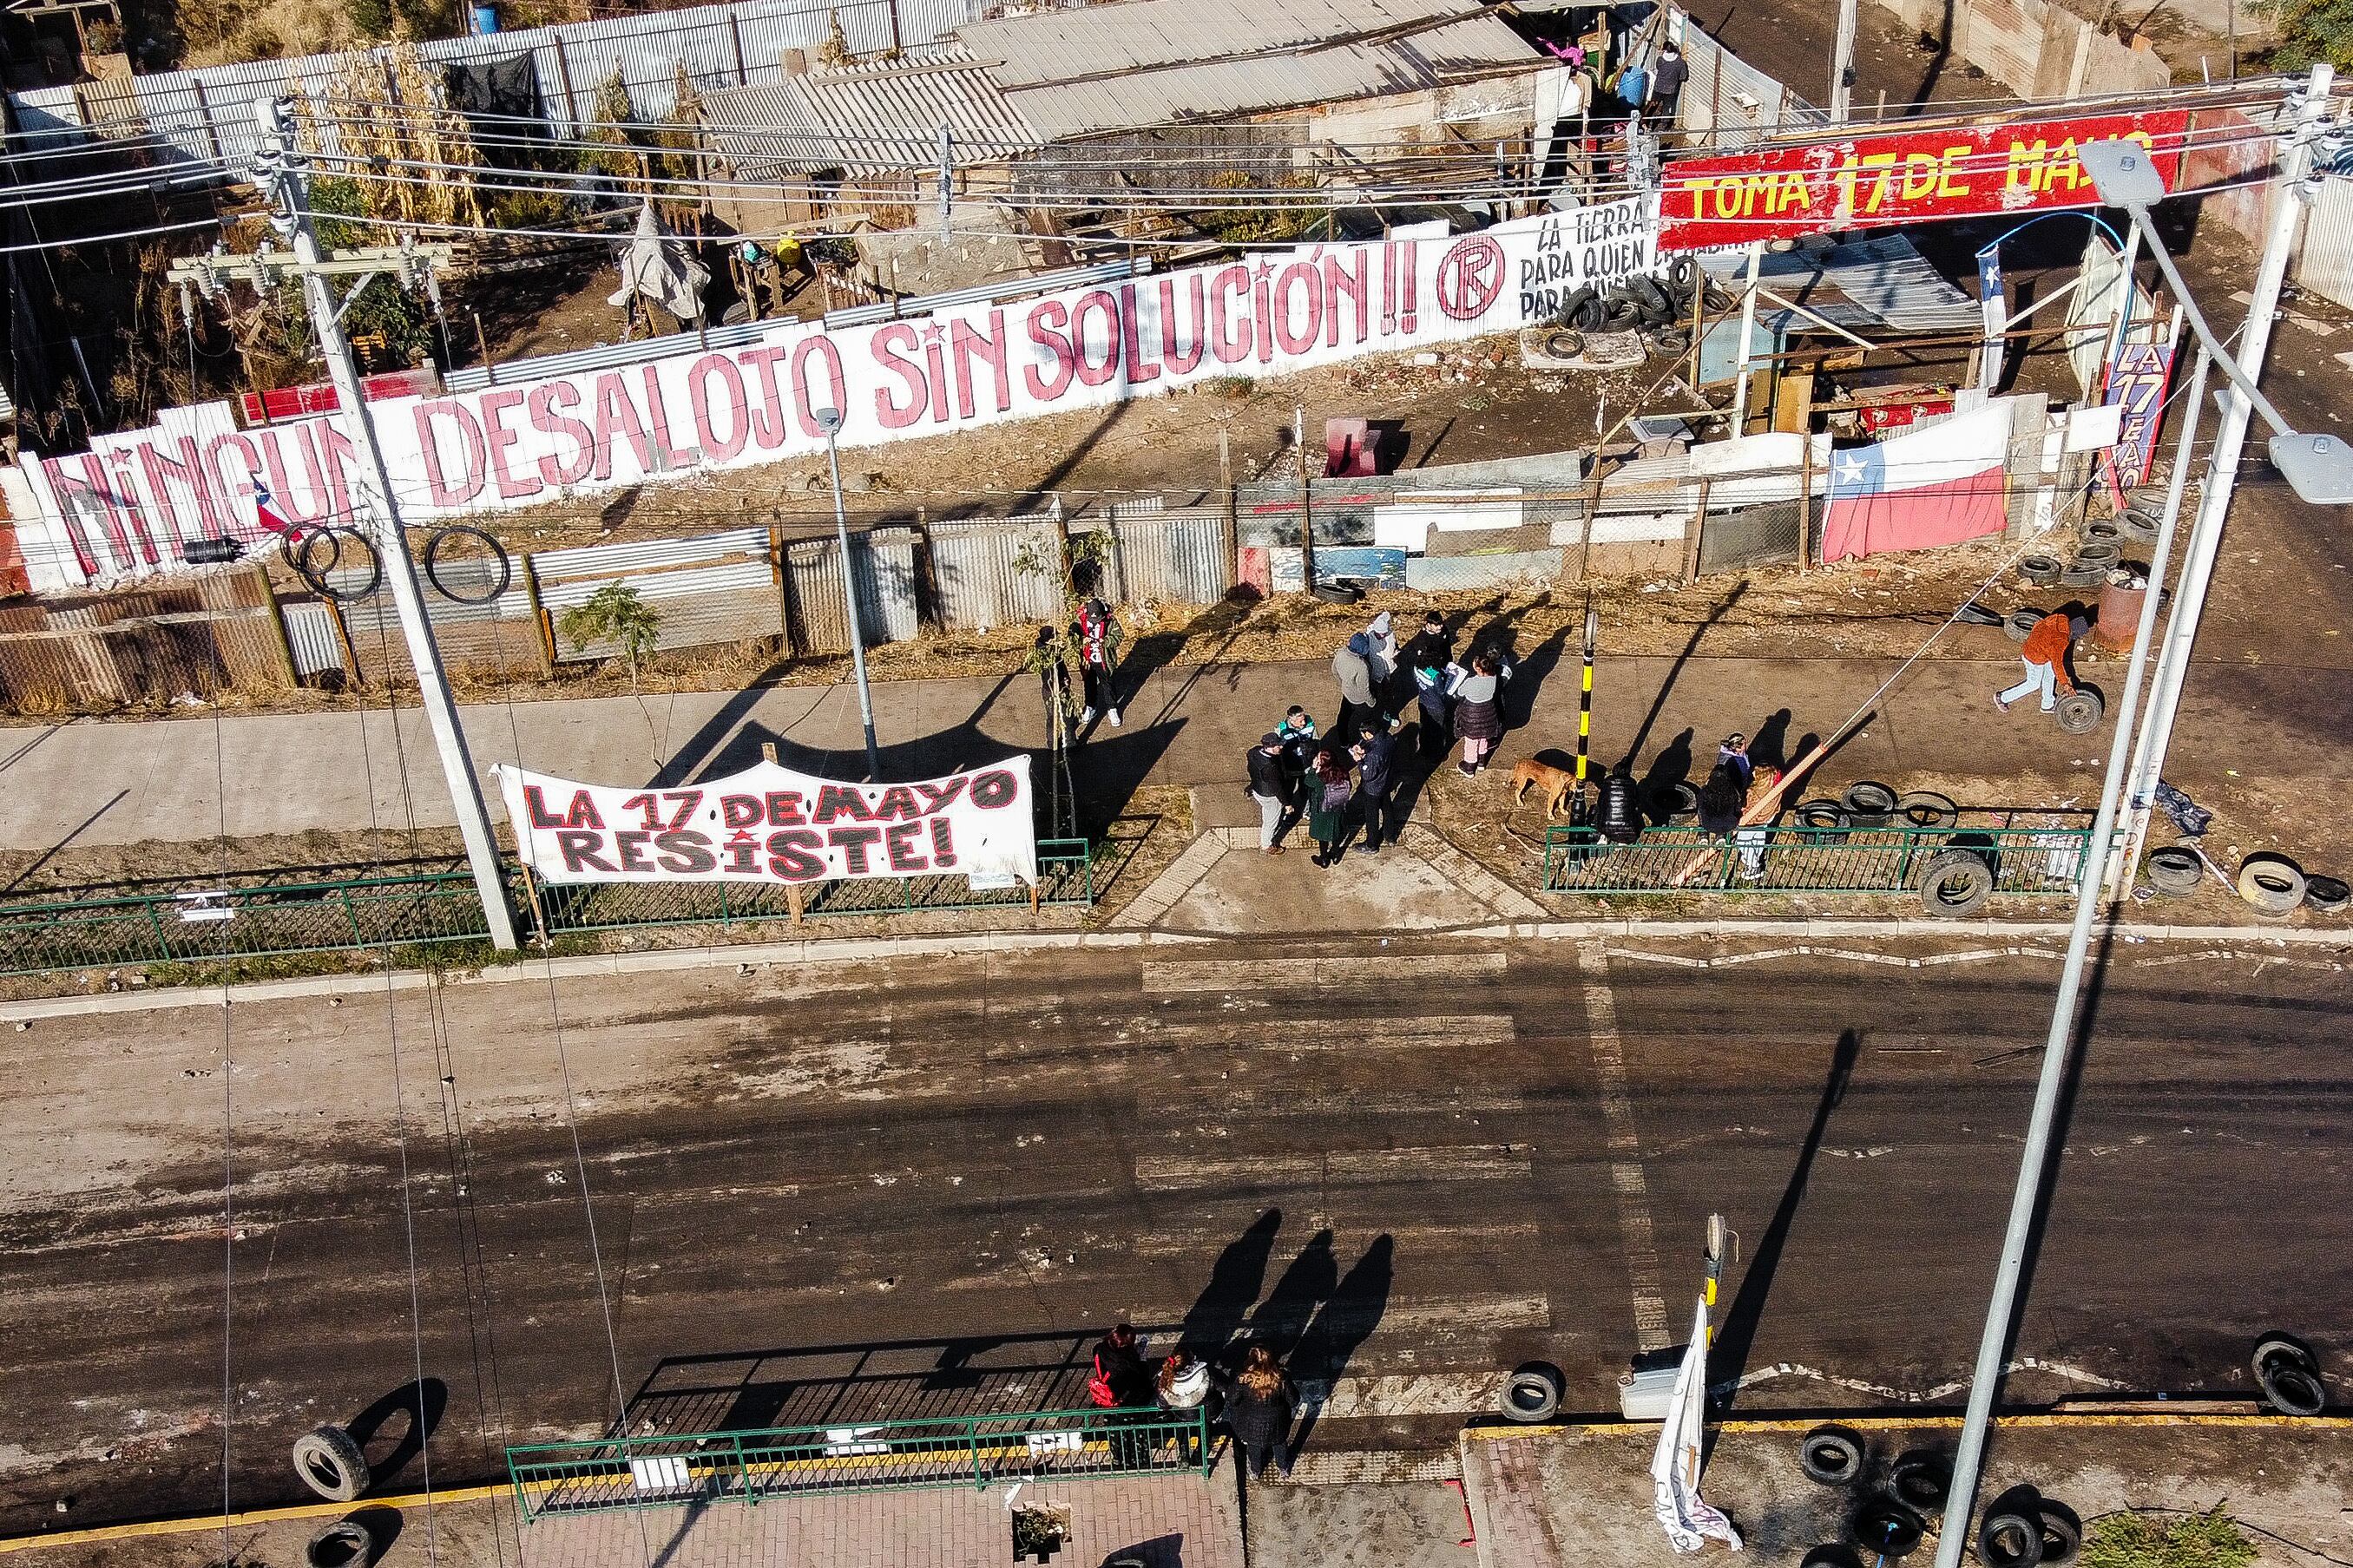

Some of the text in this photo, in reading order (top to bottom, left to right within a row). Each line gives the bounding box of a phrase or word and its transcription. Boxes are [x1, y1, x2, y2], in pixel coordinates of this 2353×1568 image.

[1683, 131, 2153, 220] TOMA 17 DE MA
[1537, 218, 1561, 253] LA
[1520, 250, 1574, 289] PARA
[2115, 345, 2166, 373] LA
[2112, 372, 2166, 416] 17
[413, 334, 847, 508] DESALOJO
[523, 768, 1018, 832] LA 17 DE MAYO
